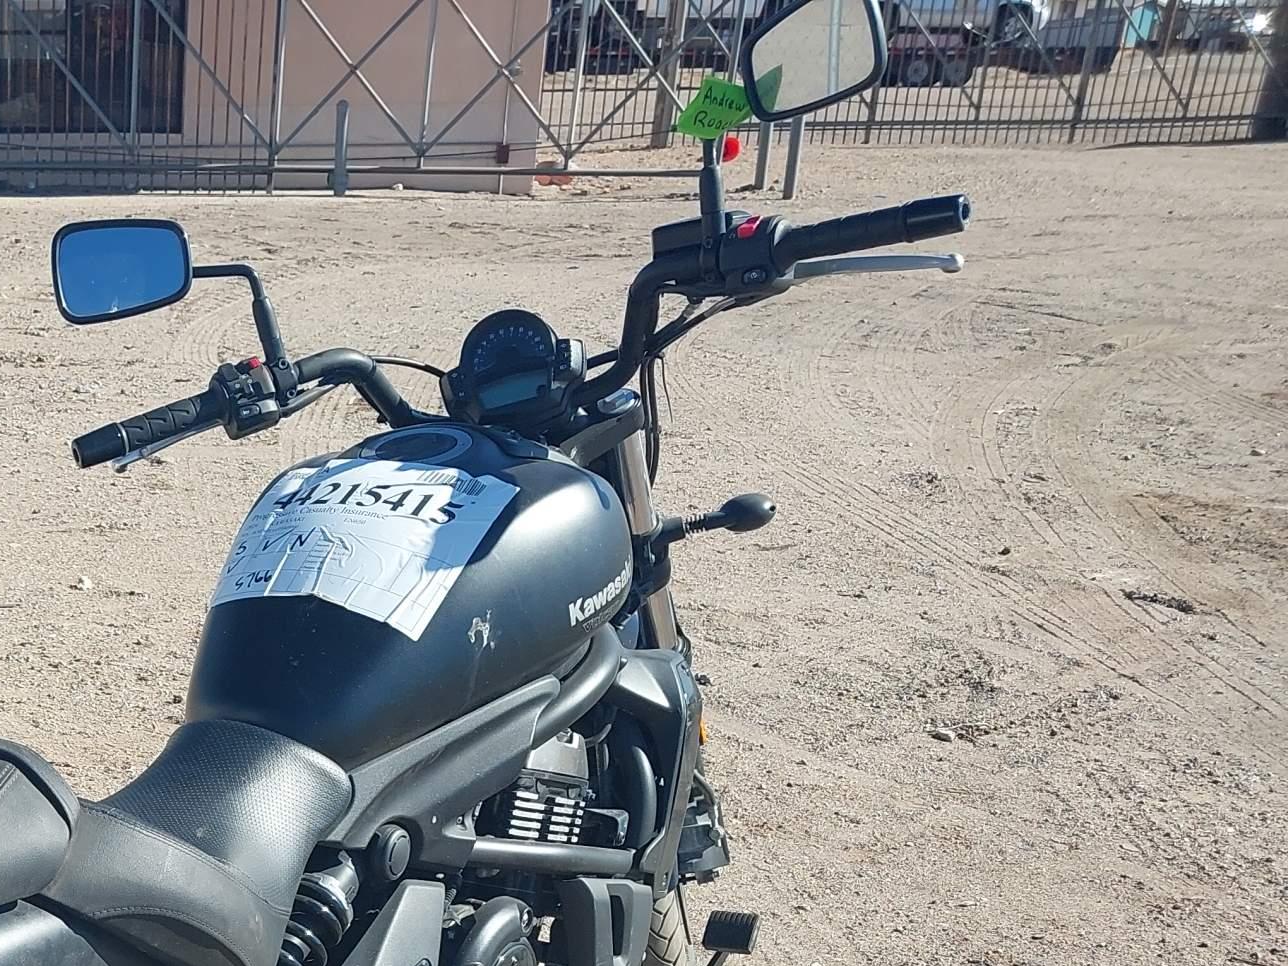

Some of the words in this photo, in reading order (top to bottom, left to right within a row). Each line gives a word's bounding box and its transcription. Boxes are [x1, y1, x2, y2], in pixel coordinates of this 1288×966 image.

[702, 86, 746, 112] Andrew
[273, 482, 465, 525] 44215415
[299, 506, 339, 517] Casualty
[340, 506, 389, 521] Insurance
